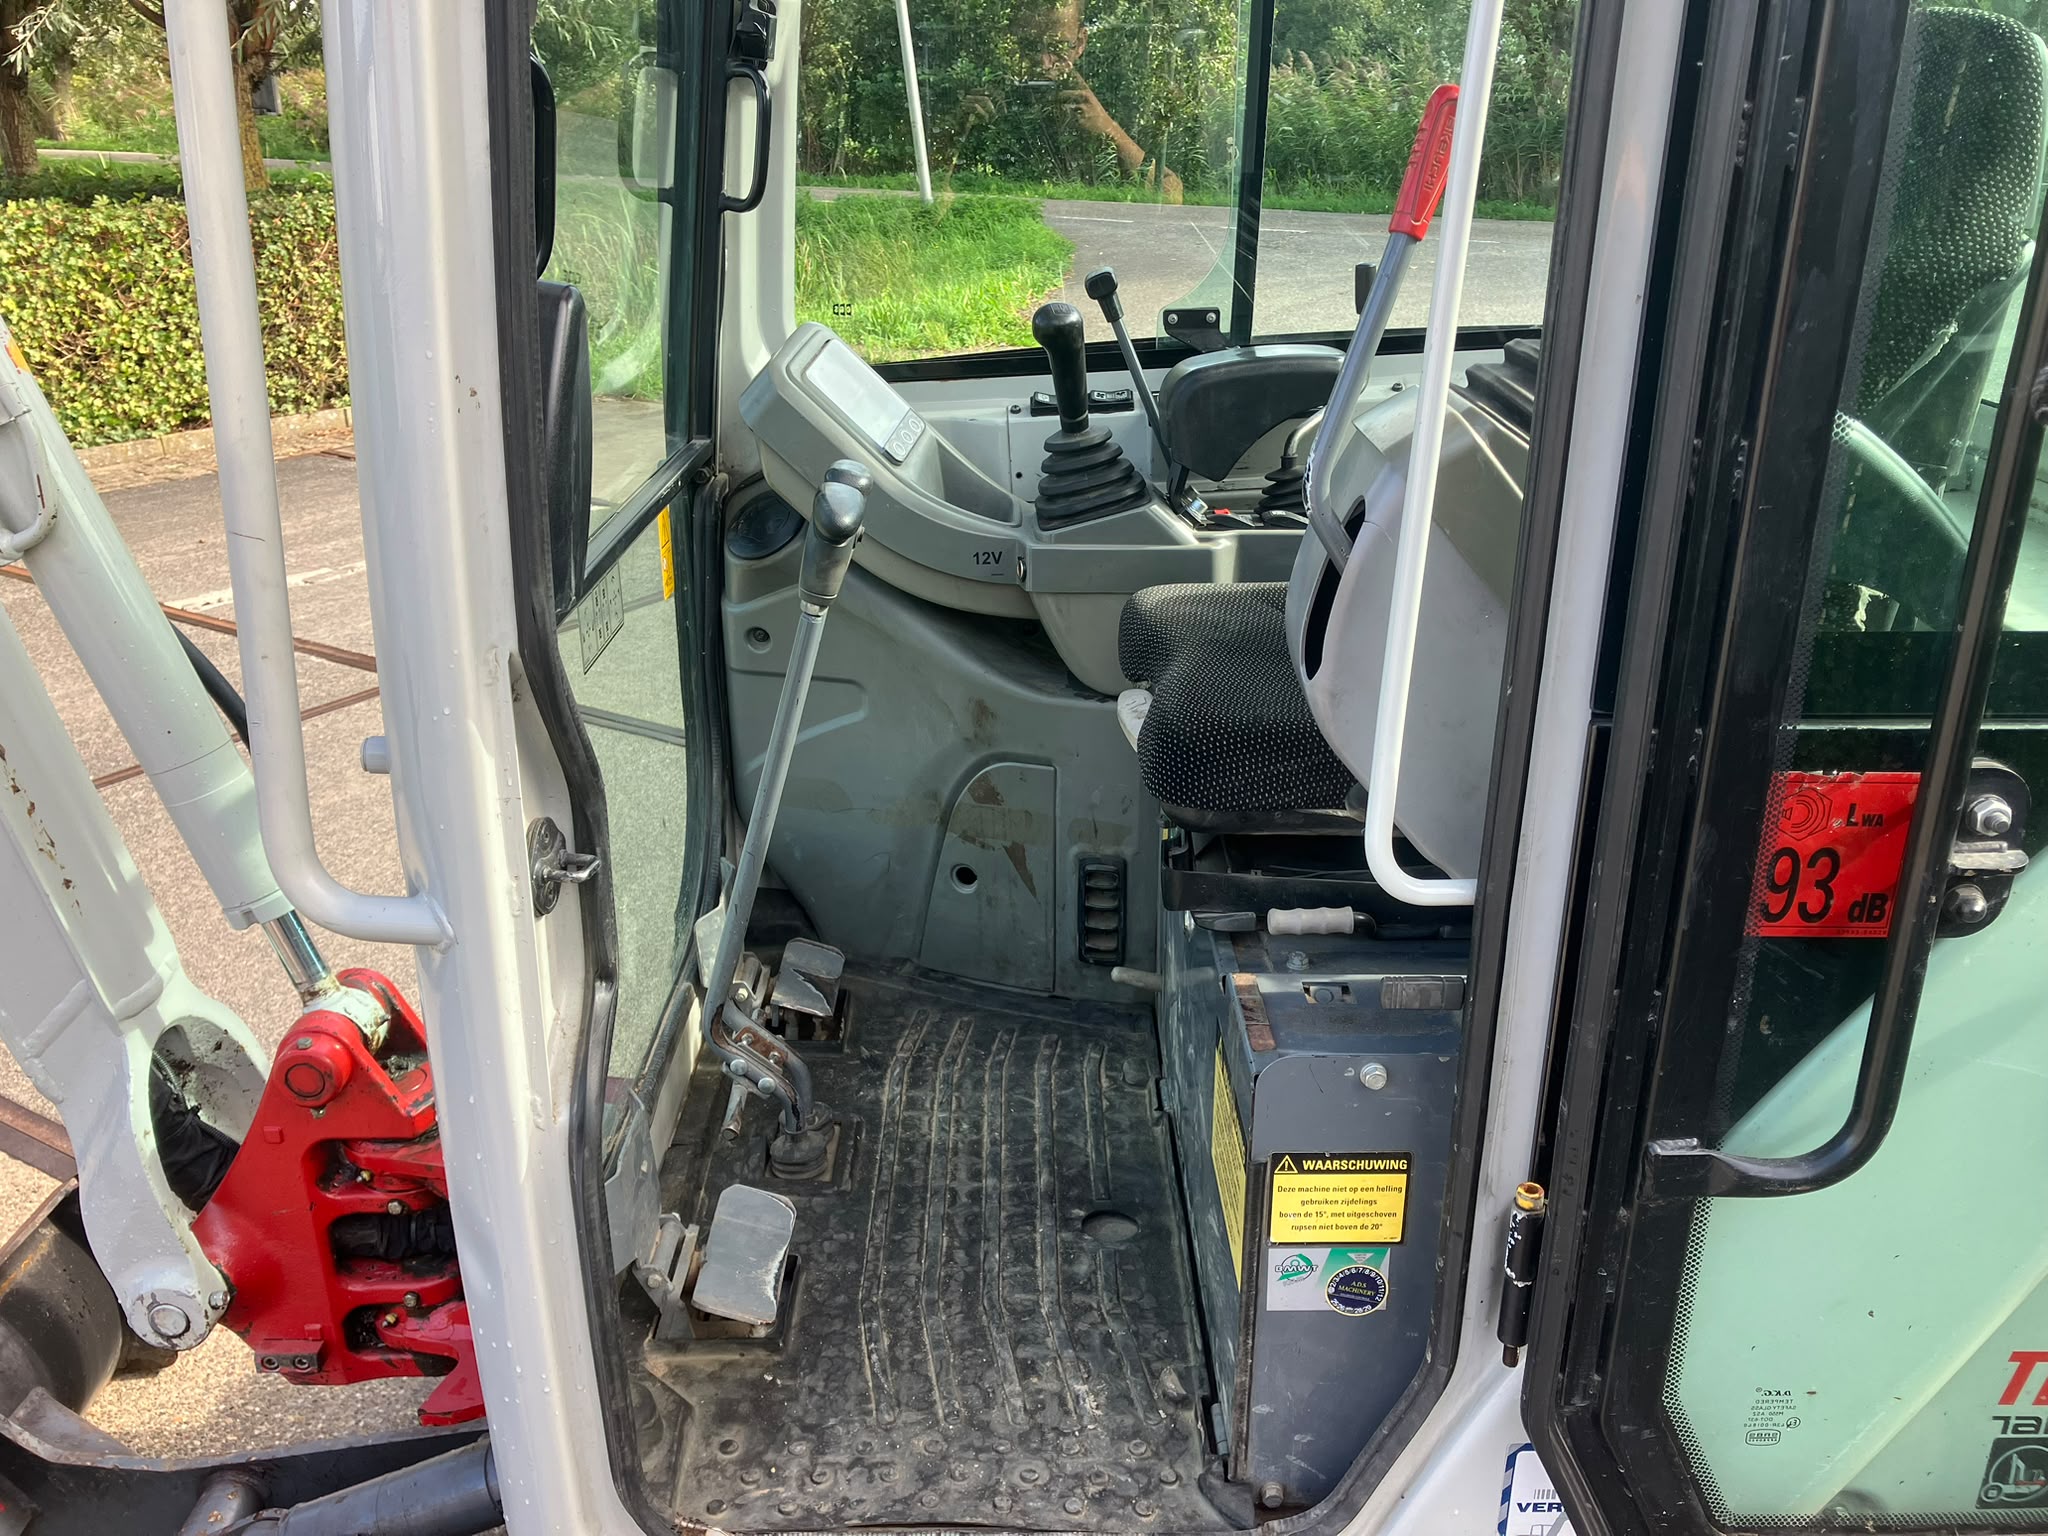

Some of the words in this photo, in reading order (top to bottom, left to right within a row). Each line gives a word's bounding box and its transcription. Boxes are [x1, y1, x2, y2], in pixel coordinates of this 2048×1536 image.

[972, 551, 1003, 565] 12V
[1760, 847, 1841, 923] 93
[1848, 893, 1888, 923] dB
[1302, 1159, 1408, 1171] WAARSCHUWING
[1277, 1185, 1296, 1193] Deze
[1298, 1185, 1330, 1193] machine
[1332, 1185, 1347, 1193] niet
[1376, 1185, 1403, 1194] helling
[1300, 1198, 1339, 1206] gebruiken
[1340, 1198, 1378, 1206] zijdelings
[1346, 1211, 1397, 1219] uitgeschoven
[1337, 1285, 1377, 1297] MACHINERY
[1992, 1415, 2048, 1435] Ta
[1516, 1502, 1566, 1513] VER
